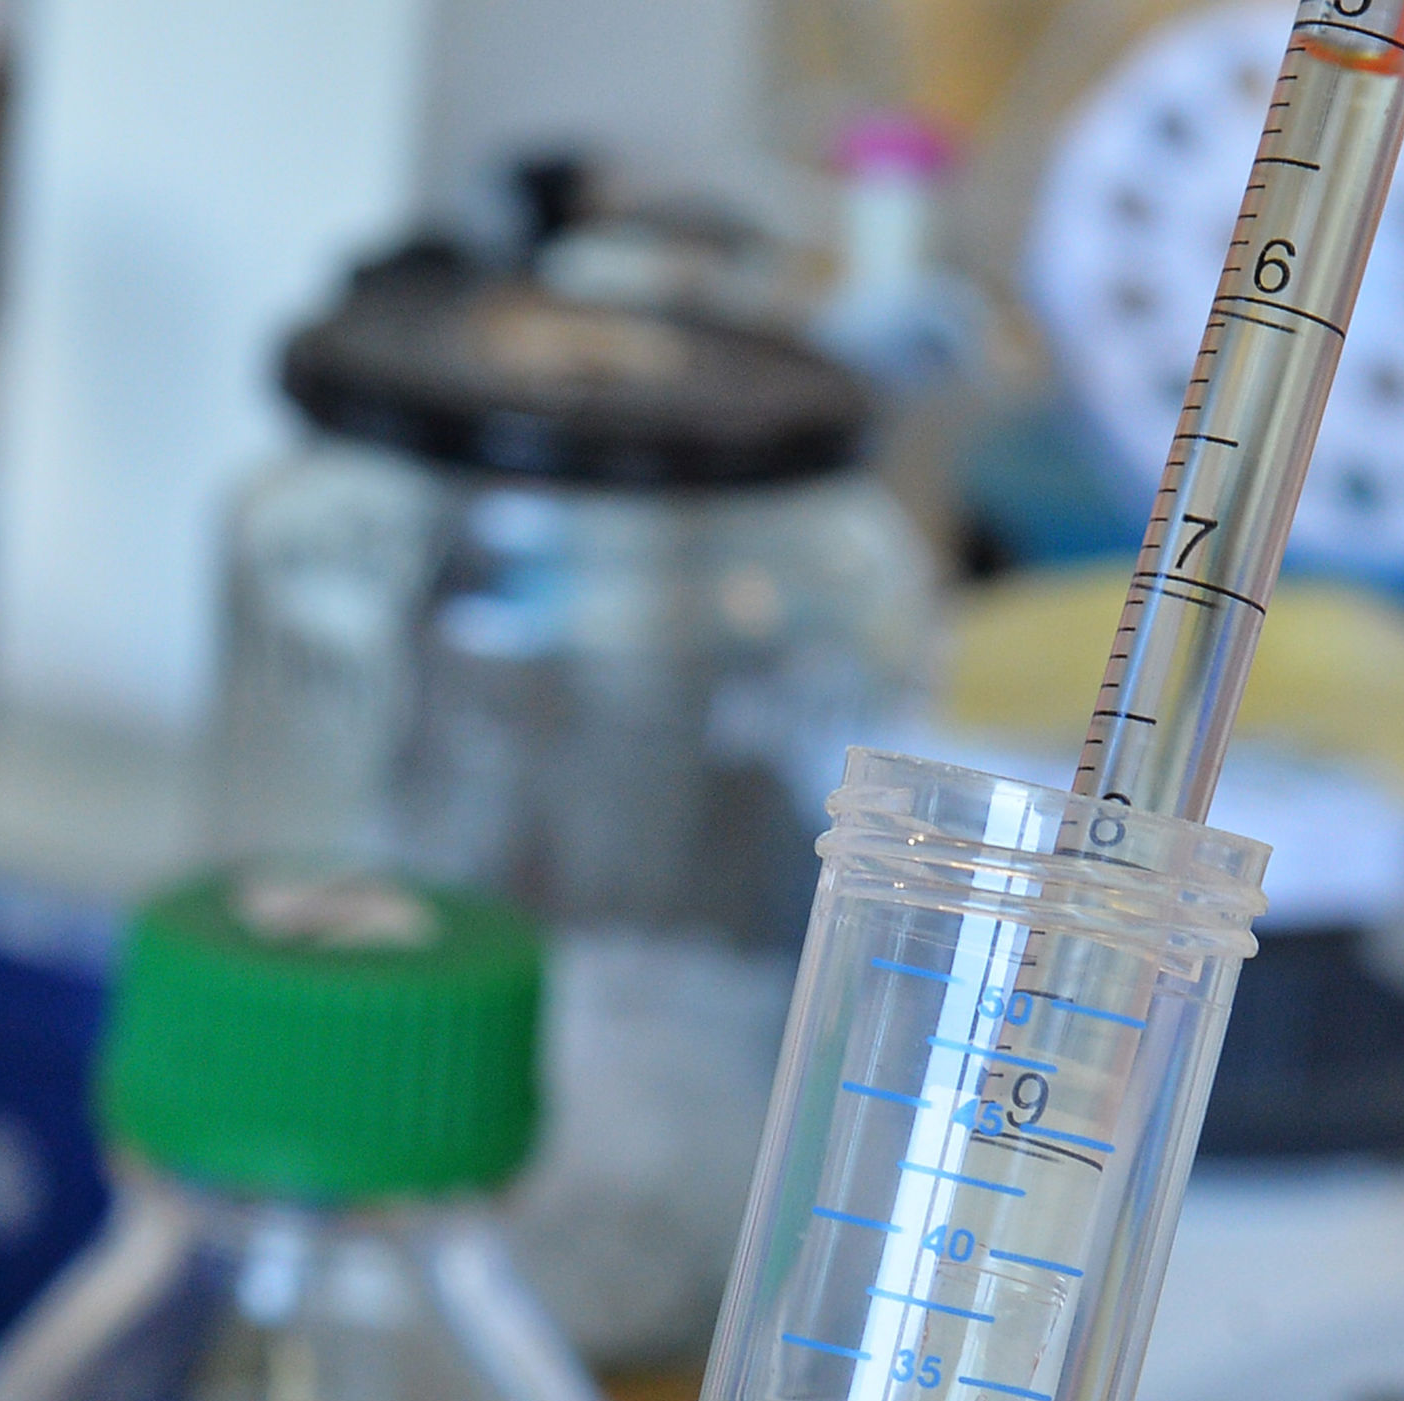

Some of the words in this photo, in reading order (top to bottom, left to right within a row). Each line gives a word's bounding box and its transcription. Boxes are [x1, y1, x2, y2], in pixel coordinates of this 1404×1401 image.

[1253, 238, 1297, 294] 6
[1172, 513, 1218, 569] 7
[1088, 792, 1132, 847] 8
[977, 986, 1034, 1026] 50
[953, 1098, 1004, 1137] 45
[1006, 1073, 1049, 1129] 9
[922, 1226, 976, 1262] 40
[890, 1350, 942, 1389] 35
